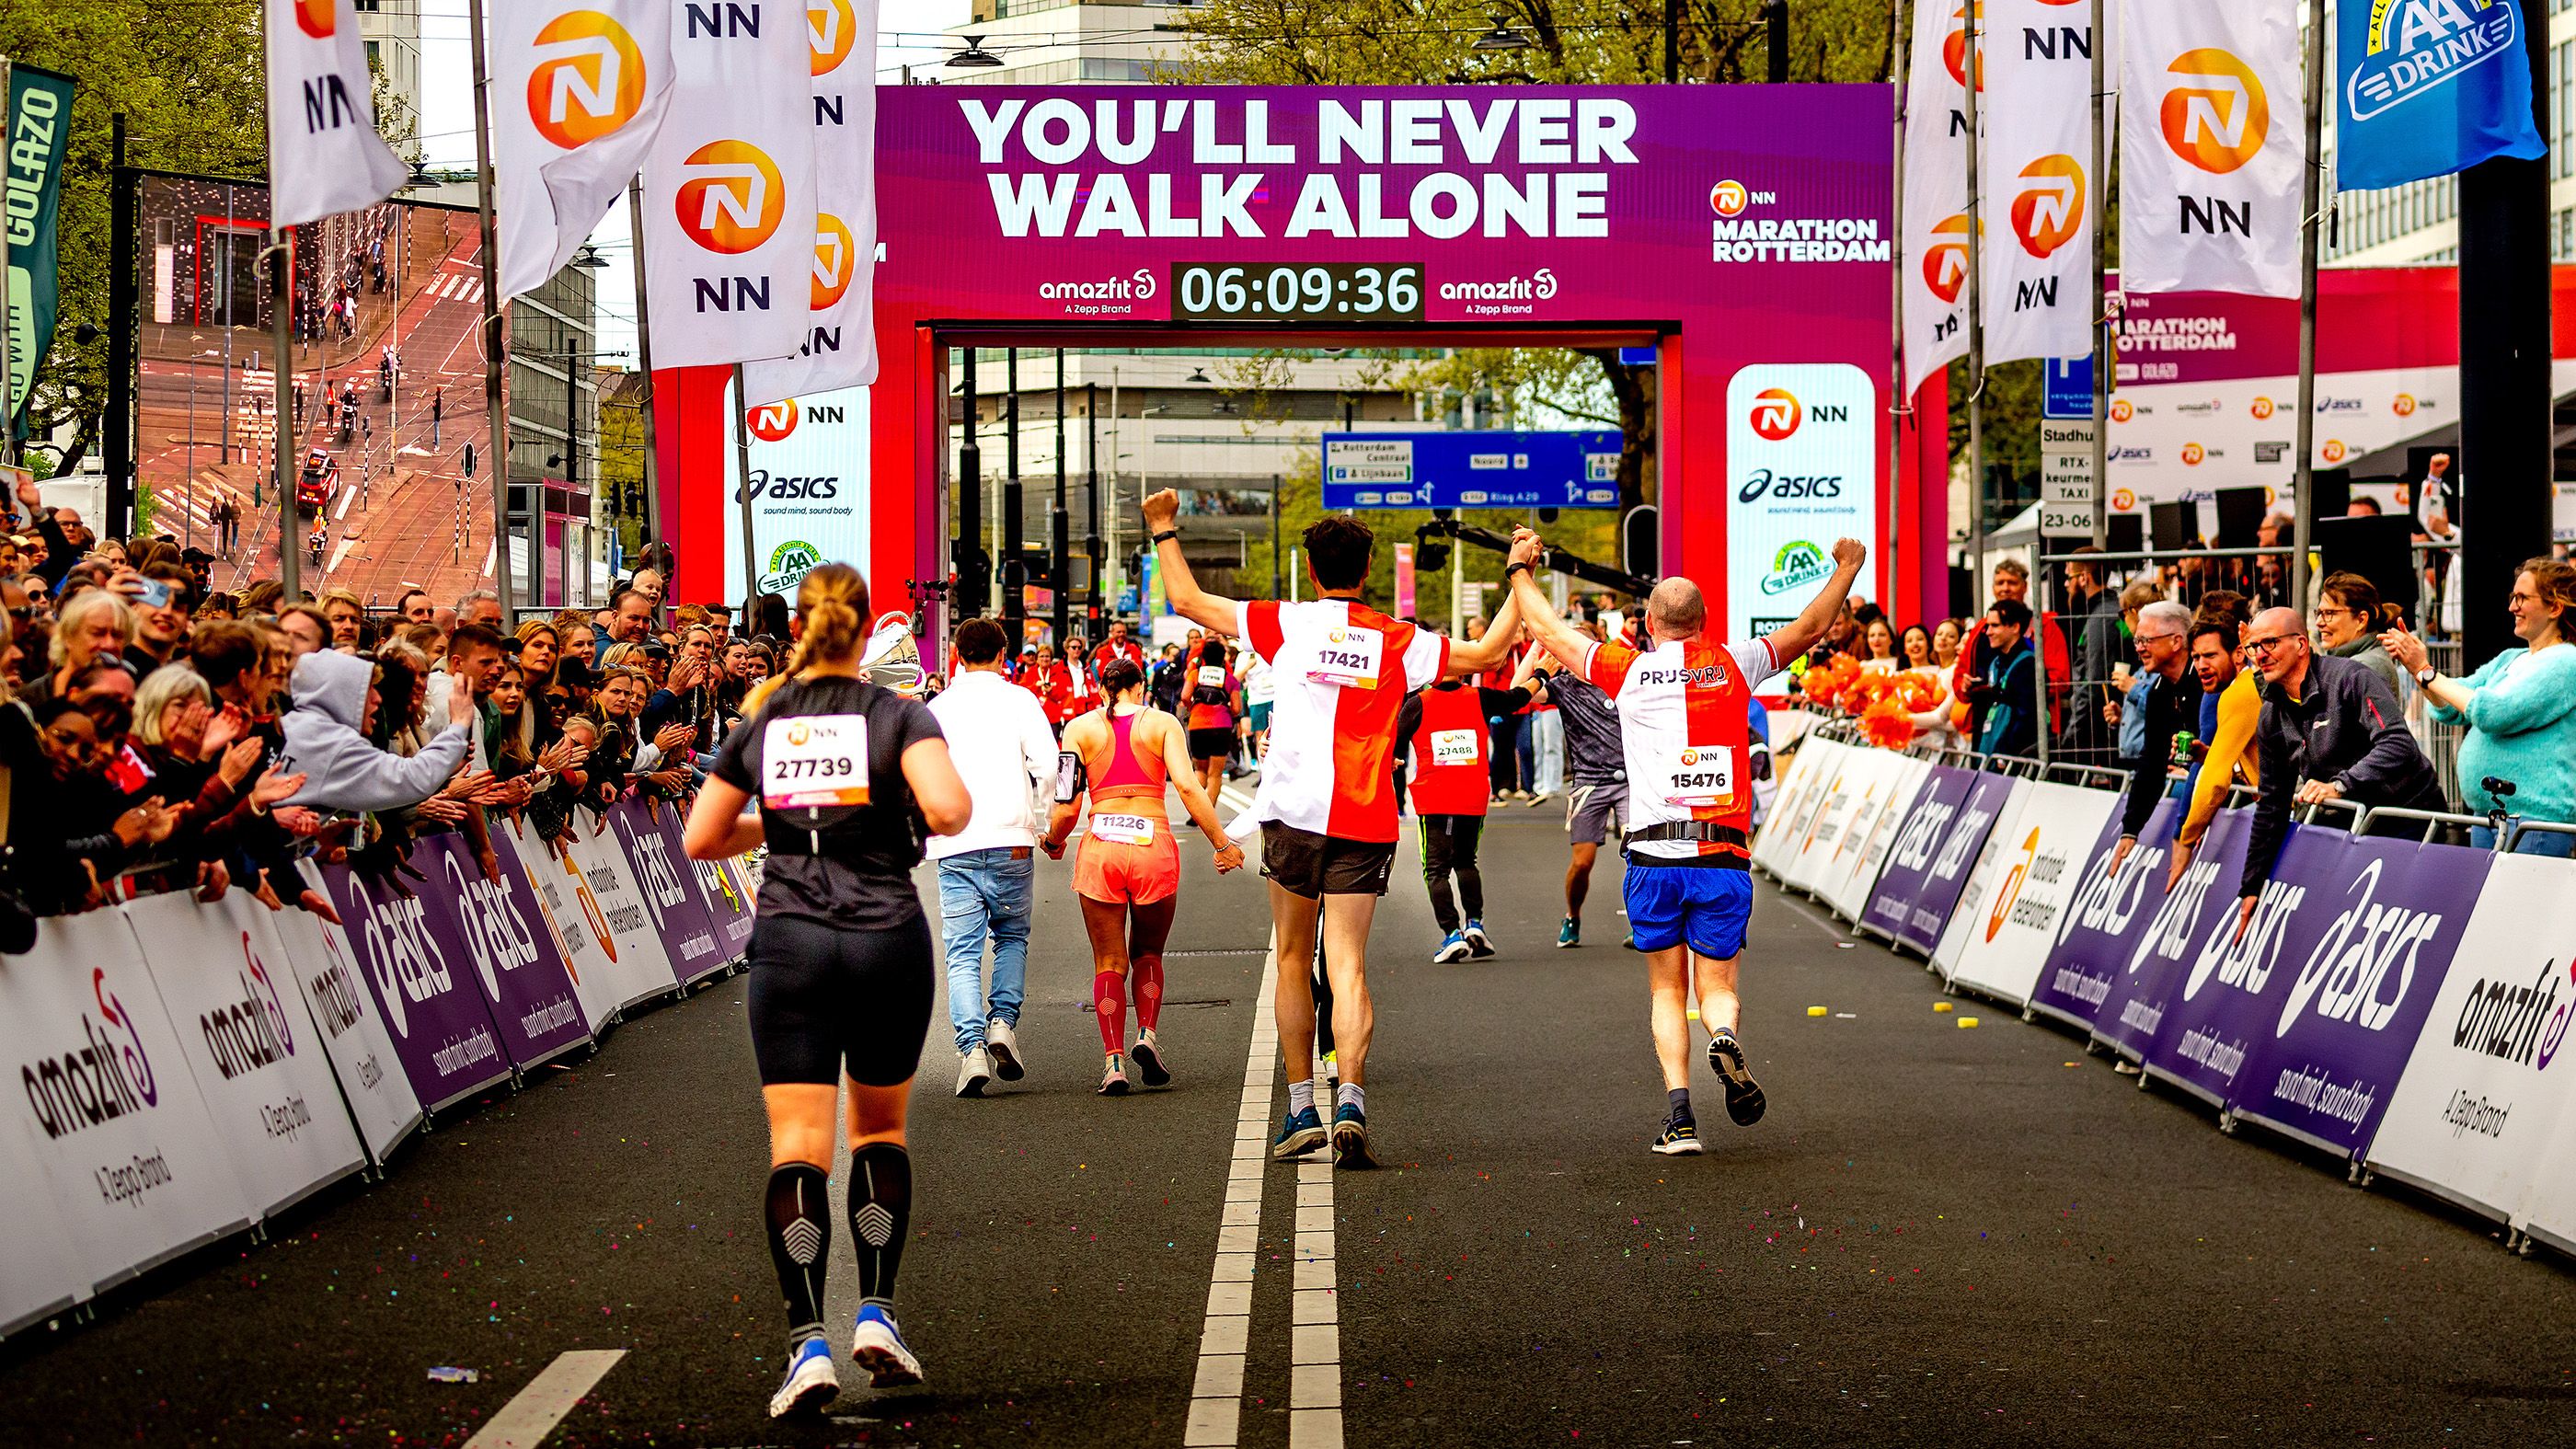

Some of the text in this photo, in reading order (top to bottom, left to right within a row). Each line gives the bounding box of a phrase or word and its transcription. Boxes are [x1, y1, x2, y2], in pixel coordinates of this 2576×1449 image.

[687, 3, 761, 39] NN
[2398, 0, 2476, 57] AA
[2388, 22, 2493, 92] DRINK
[958, 98, 1639, 166] YOU'LL NEVER
[6, 86, 59, 247] GOLAZO
[987, 172, 1609, 239] WALK ALONE
[1751, 191, 1777, 205] NN
[2179, 195, 2250, 239] NN
[1712, 219, 1878, 241] MARATHON
[1712, 239, 1891, 263] ROTTERDAM
[693, 276, 771, 313] NN
[1039, 276, 1132, 300] amazfit
[1180, 267, 1419, 314] 06:09:36
[1439, 276, 1533, 300] amazfit
[1064, 305, 1132, 316] A Zepp Brand
[1465, 305, 1533, 316] A Zepp Brand
[2113, 316, 2227, 336] ARATHON
[2116, 332, 2237, 352] OTTERDAM
[808, 407, 844, 423] NN
[1811, 406, 1847, 422] NN
[2060, 457, 2089, 468] RTX-
[769, 477, 838, 500] asics
[1773, 476, 1842, 498] asics
[2045, 473, 2093, 483] keurme
[2060, 488, 2089, 499] TAXI
[764, 506, 853, 516] sound mind, sound body
[2044, 514, 2091, 528] 23-06
[785, 552, 812, 574] AA
[1788, 552, 1815, 573] AA
[1348, 632, 1366, 643] NN
[1318, 650, 1370, 670] 17421
[1438, 746, 1473, 756] 27488
[1700, 753, 1718, 762] NN
[776, 757, 853, 779] 27739
[1671, 773, 1726, 788] 15476
[1102, 816, 1145, 831] 11226
[470, 873, 539, 972] asics
[377, 895, 454, 1003] asics
[2317, 903, 2443, 1032] asics
[2454, 957, 2560, 1066] amazfit
[200, 970, 286, 1081] amazfit
[22, 1012, 143, 1141] amazfit
[2274, 1064, 2310, 1102] sound
[2317, 1079, 2359, 1119] sound
[2442, 1088, 2513, 1140] A Zepp Brand
[94, 1145, 173, 1209] A Zepp Brand
